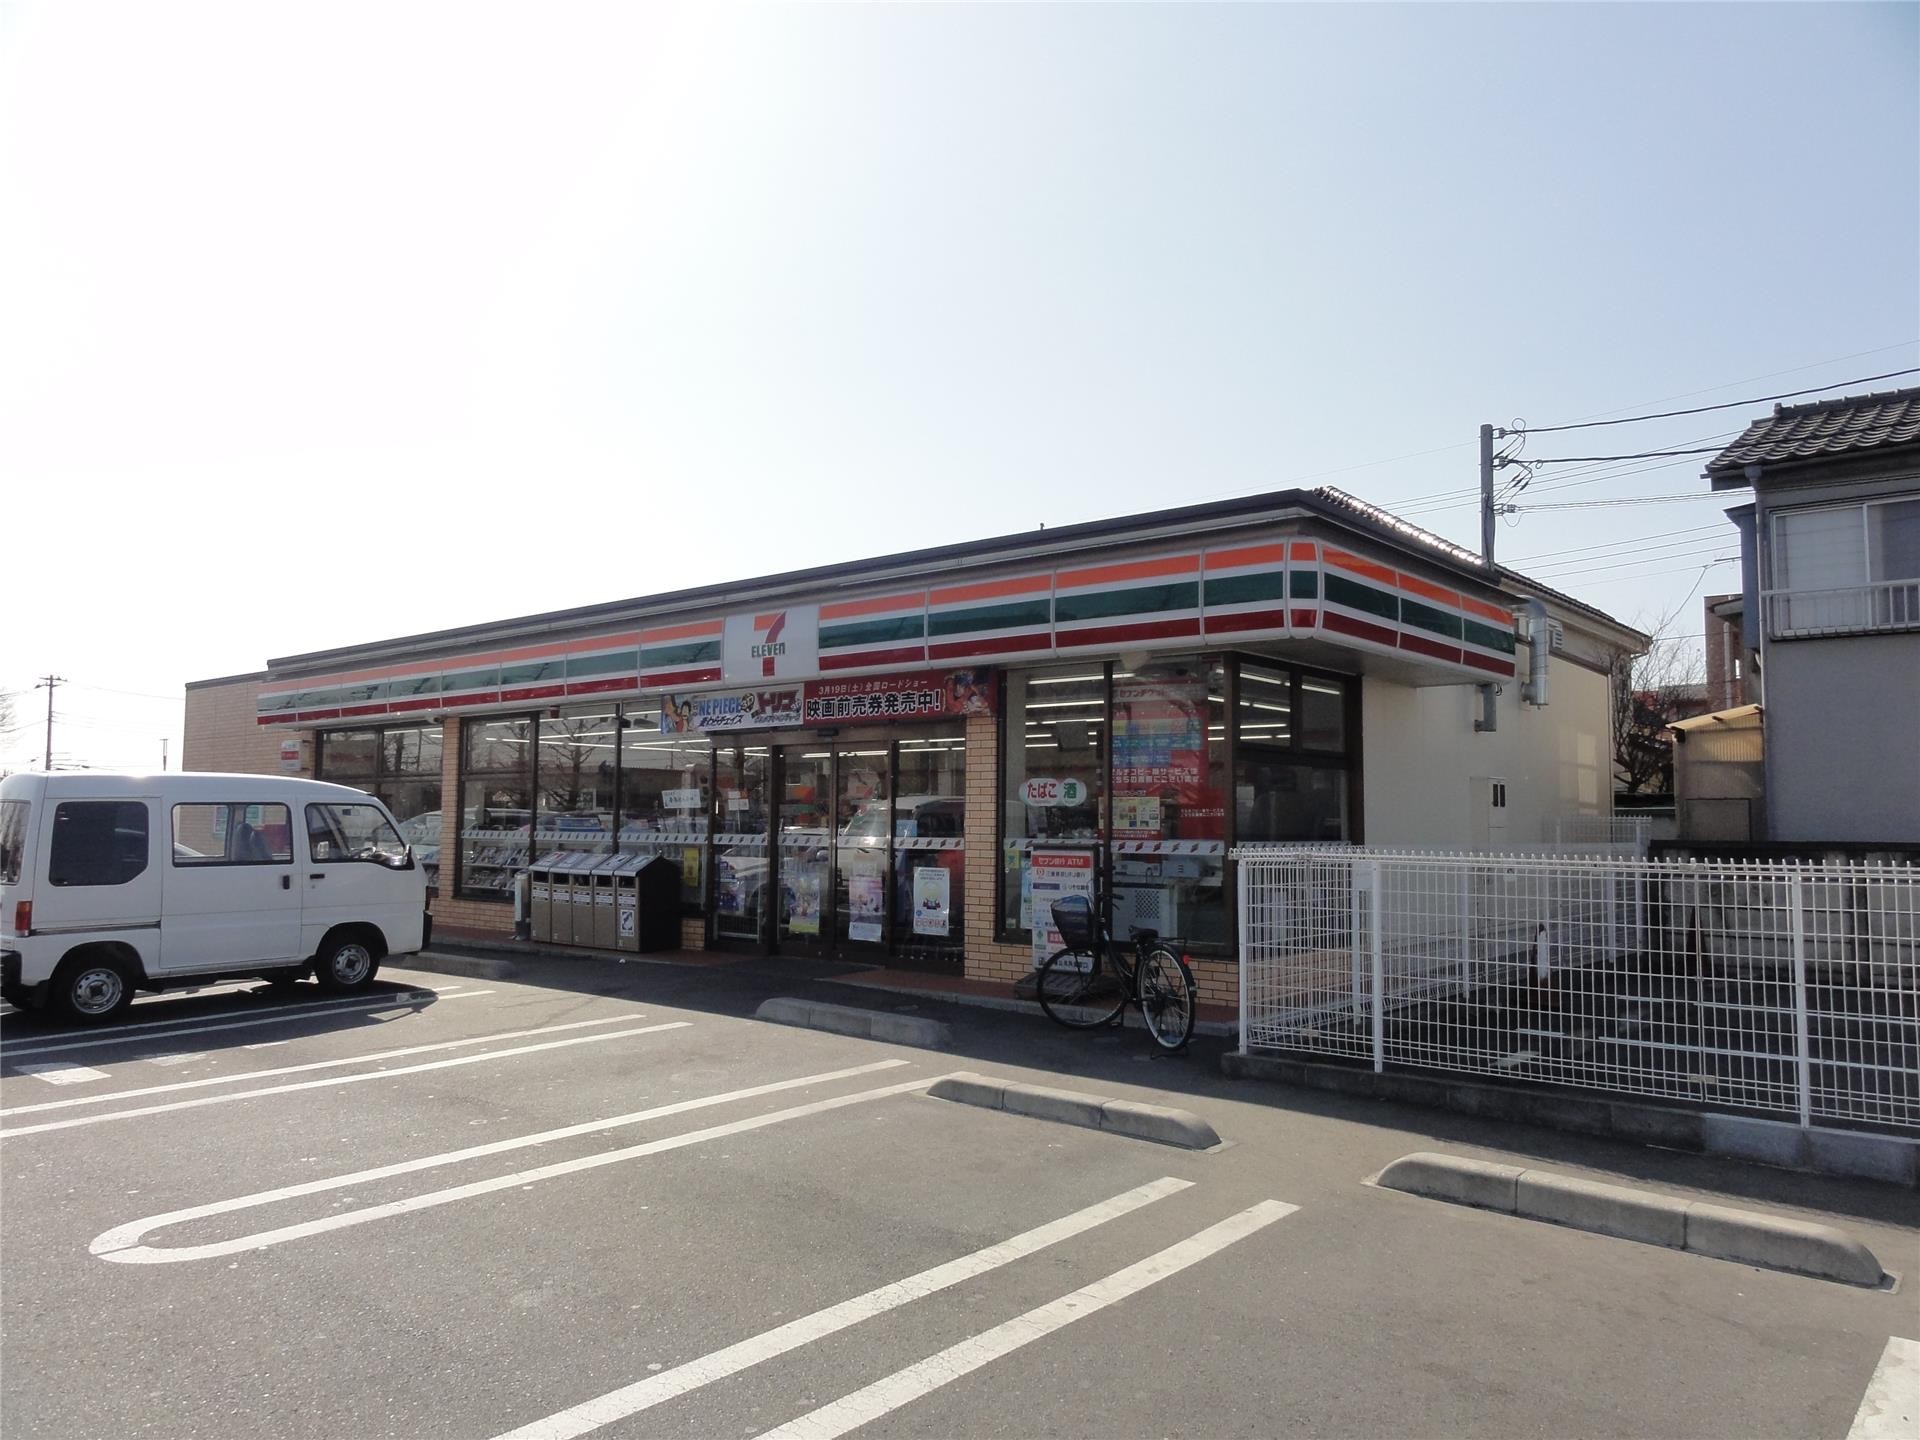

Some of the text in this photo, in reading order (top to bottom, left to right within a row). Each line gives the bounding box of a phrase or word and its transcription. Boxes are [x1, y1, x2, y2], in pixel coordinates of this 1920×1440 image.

[806, 689, 941, 720] 映画前売券発売中!
[1027, 782, 1059, 800] たばこ
[1063, 782, 1078, 800] 酒
